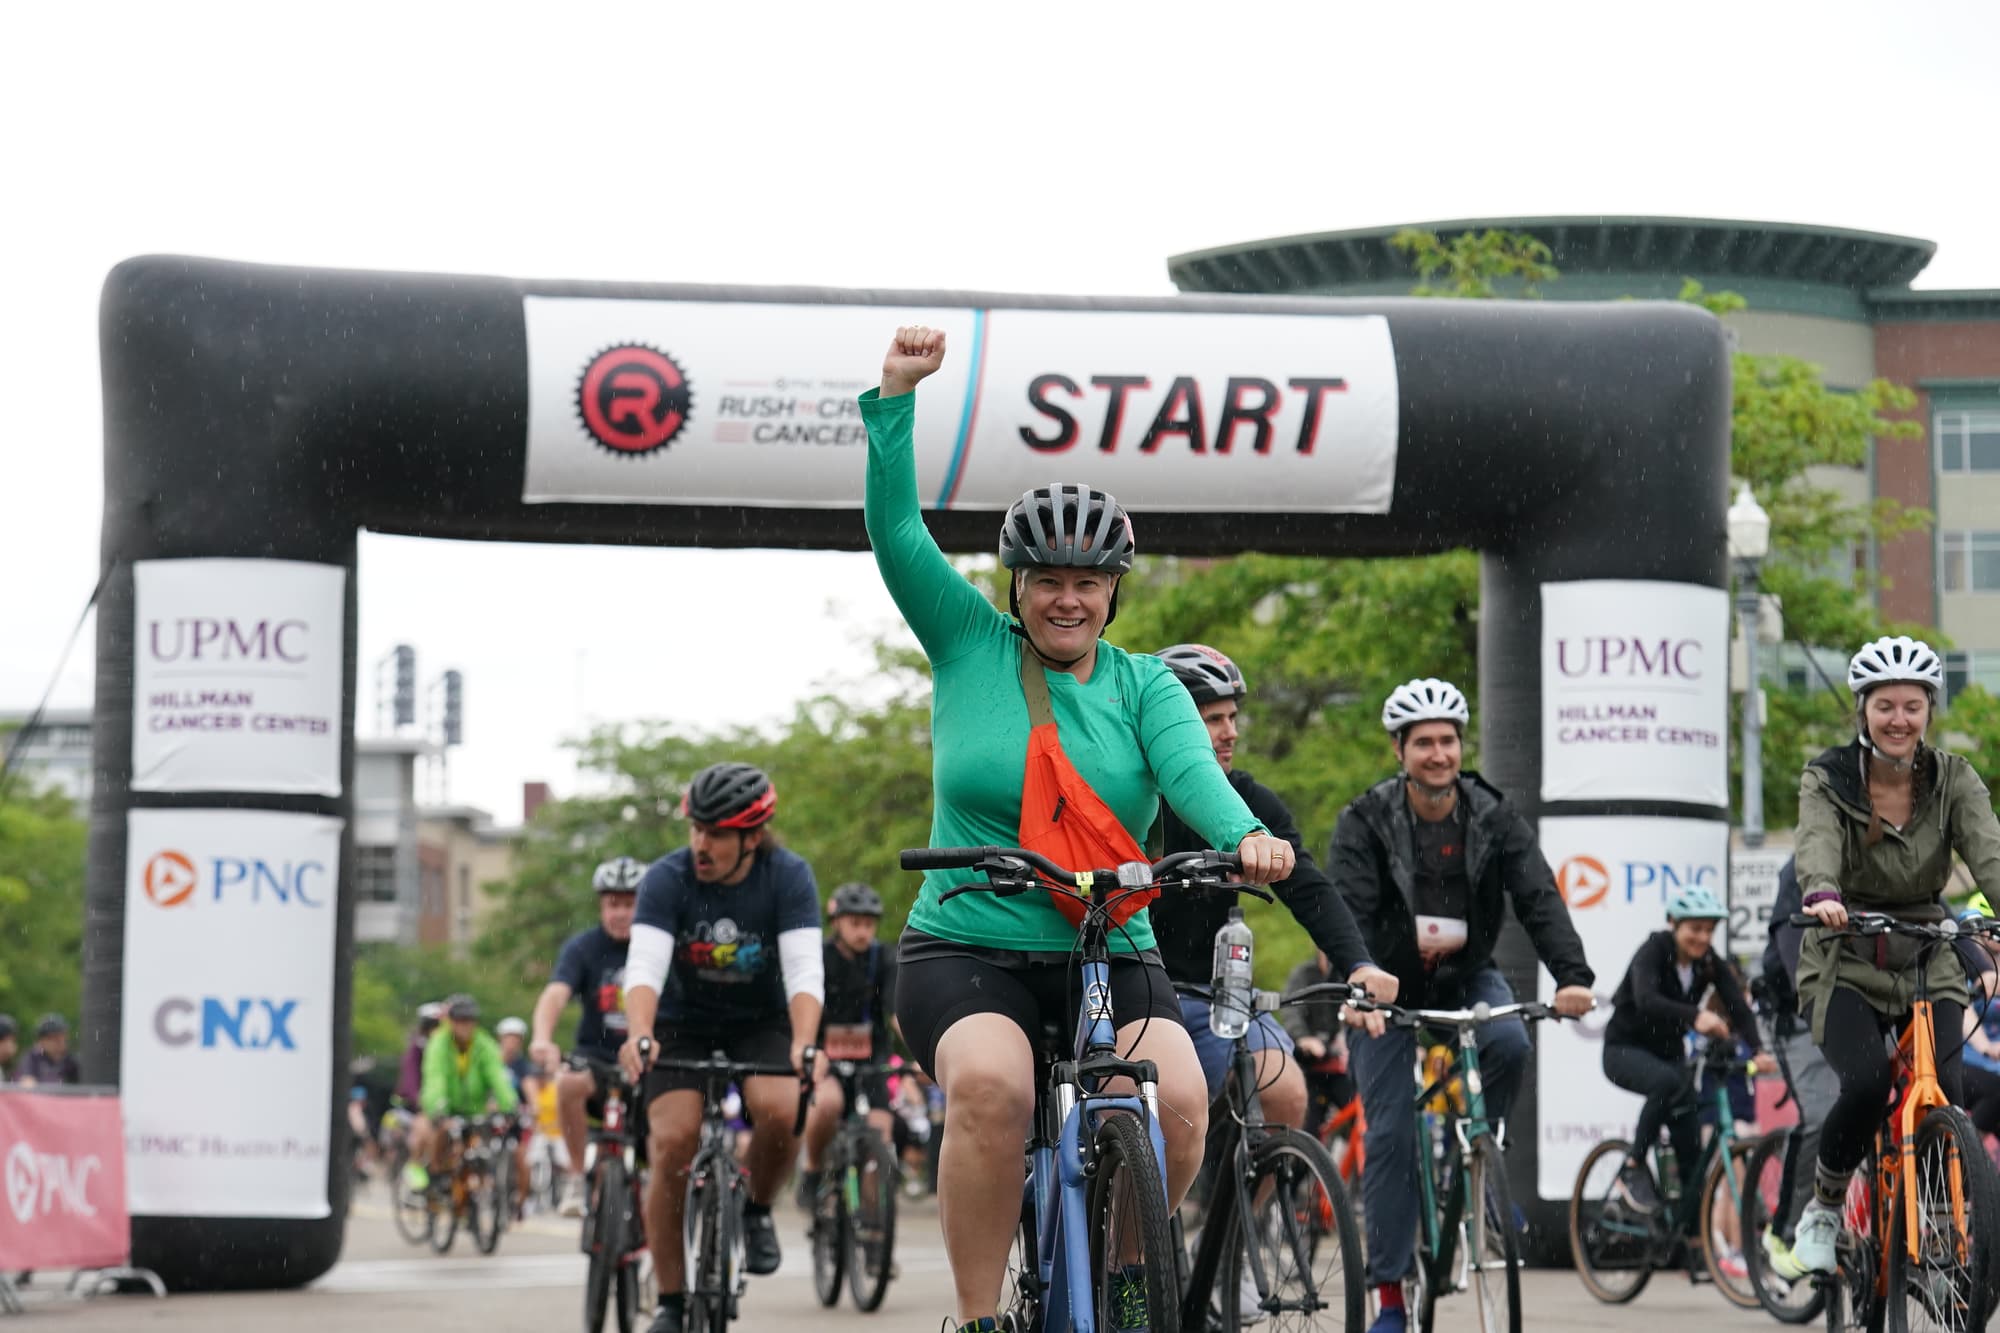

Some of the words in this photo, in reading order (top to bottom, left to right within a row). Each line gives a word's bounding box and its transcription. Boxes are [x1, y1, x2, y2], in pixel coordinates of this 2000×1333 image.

[718, 395, 797, 417] RUSH
[816, 398, 860, 418] CR
[1018, 373, 1347, 456] START
[753, 422, 868, 445] CANCER
[149, 617, 311, 663] UPMC
[1556, 637, 1704, 679] UPMC
[150, 691, 254, 710] HILLMAN
[1557, 705, 1657, 721] HILLMAN
[150, 714, 243, 733] CANCER
[251, 716, 330, 735] CENTER
[1557, 727, 1649, 745] CANCER
[1655, 727, 1721, 748] CENTER
[210, 857, 326, 908] PNC
[153, 996, 299, 1050] CNX
[39, 1154, 100, 1217] PNC
